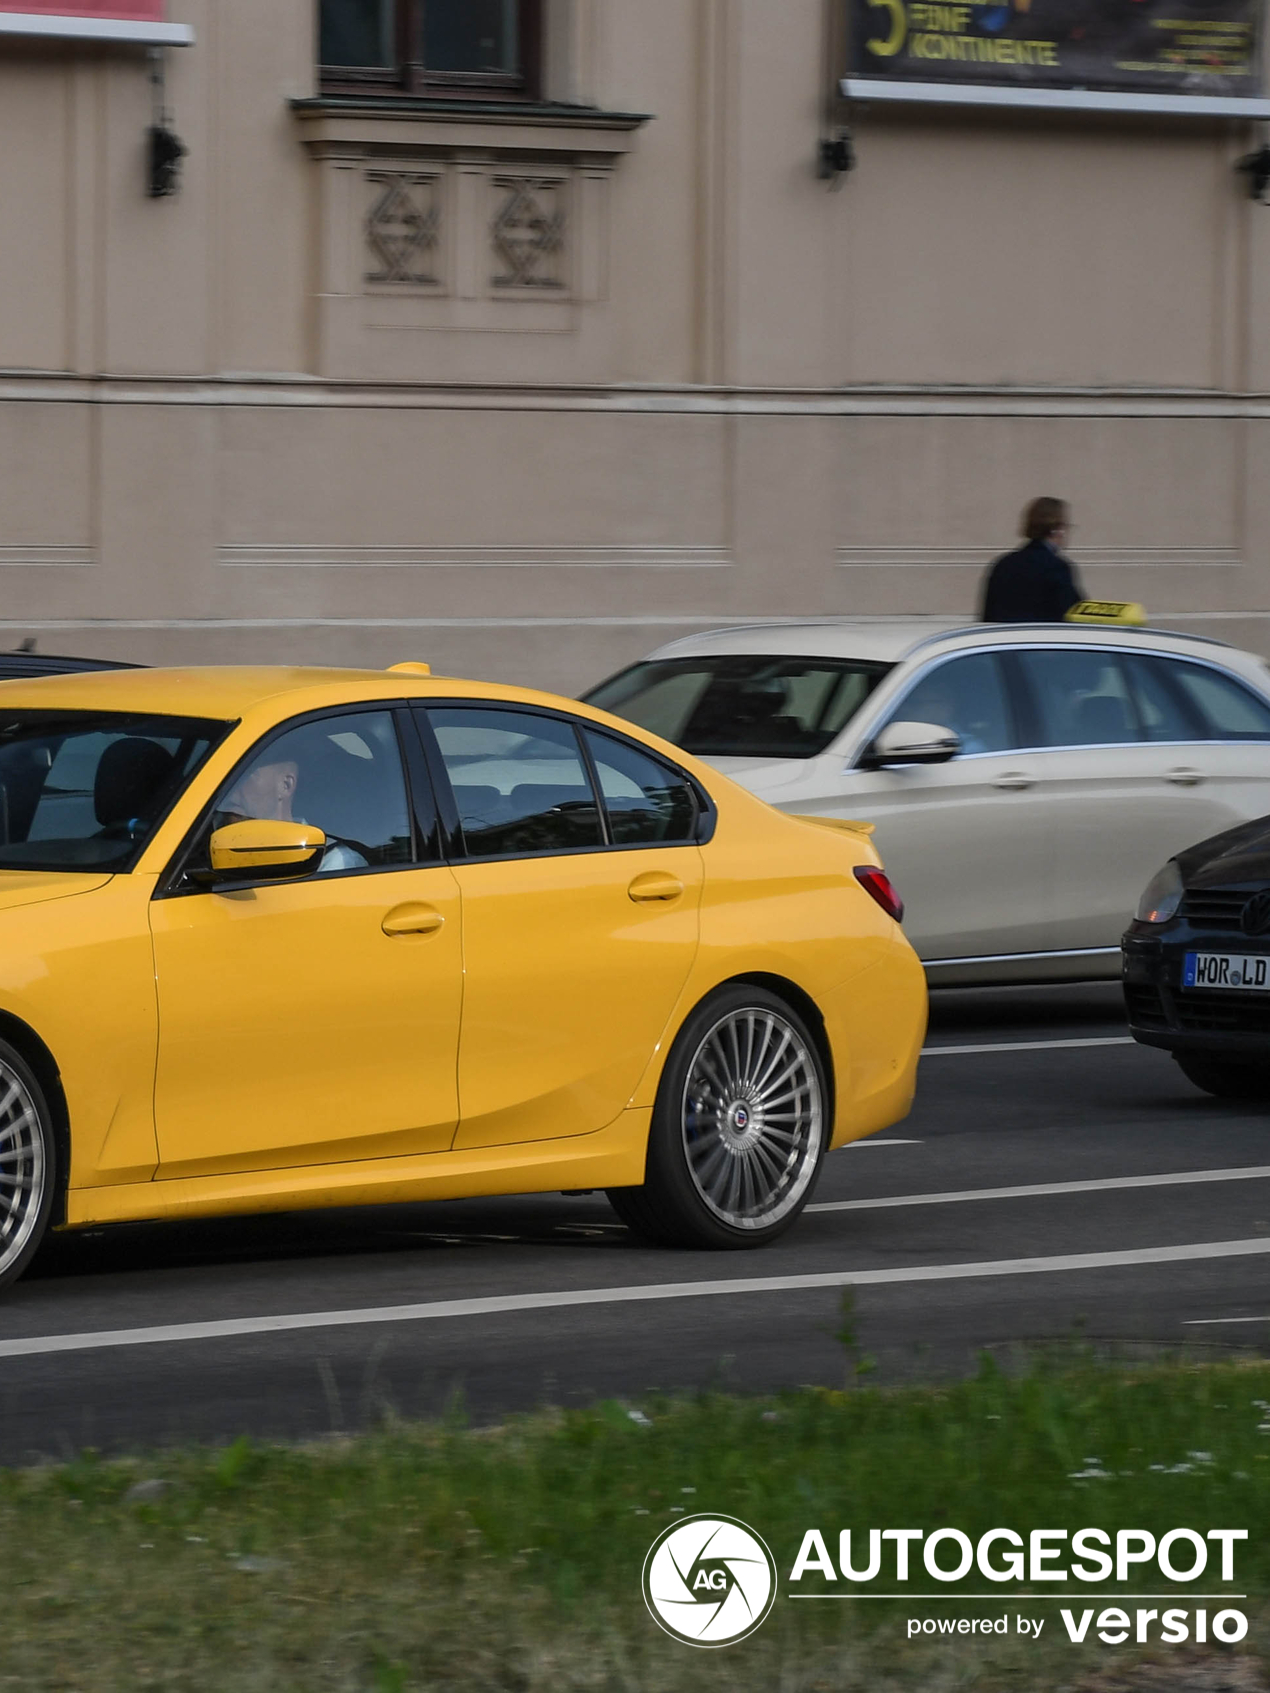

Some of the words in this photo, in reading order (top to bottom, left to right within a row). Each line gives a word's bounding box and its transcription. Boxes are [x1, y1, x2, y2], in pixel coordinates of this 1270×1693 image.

[907, 33, 1062, 66] KONTINENTE
[1197, 956, 1229, 984] WOR
[1242, 959, 1267, 985] LD
